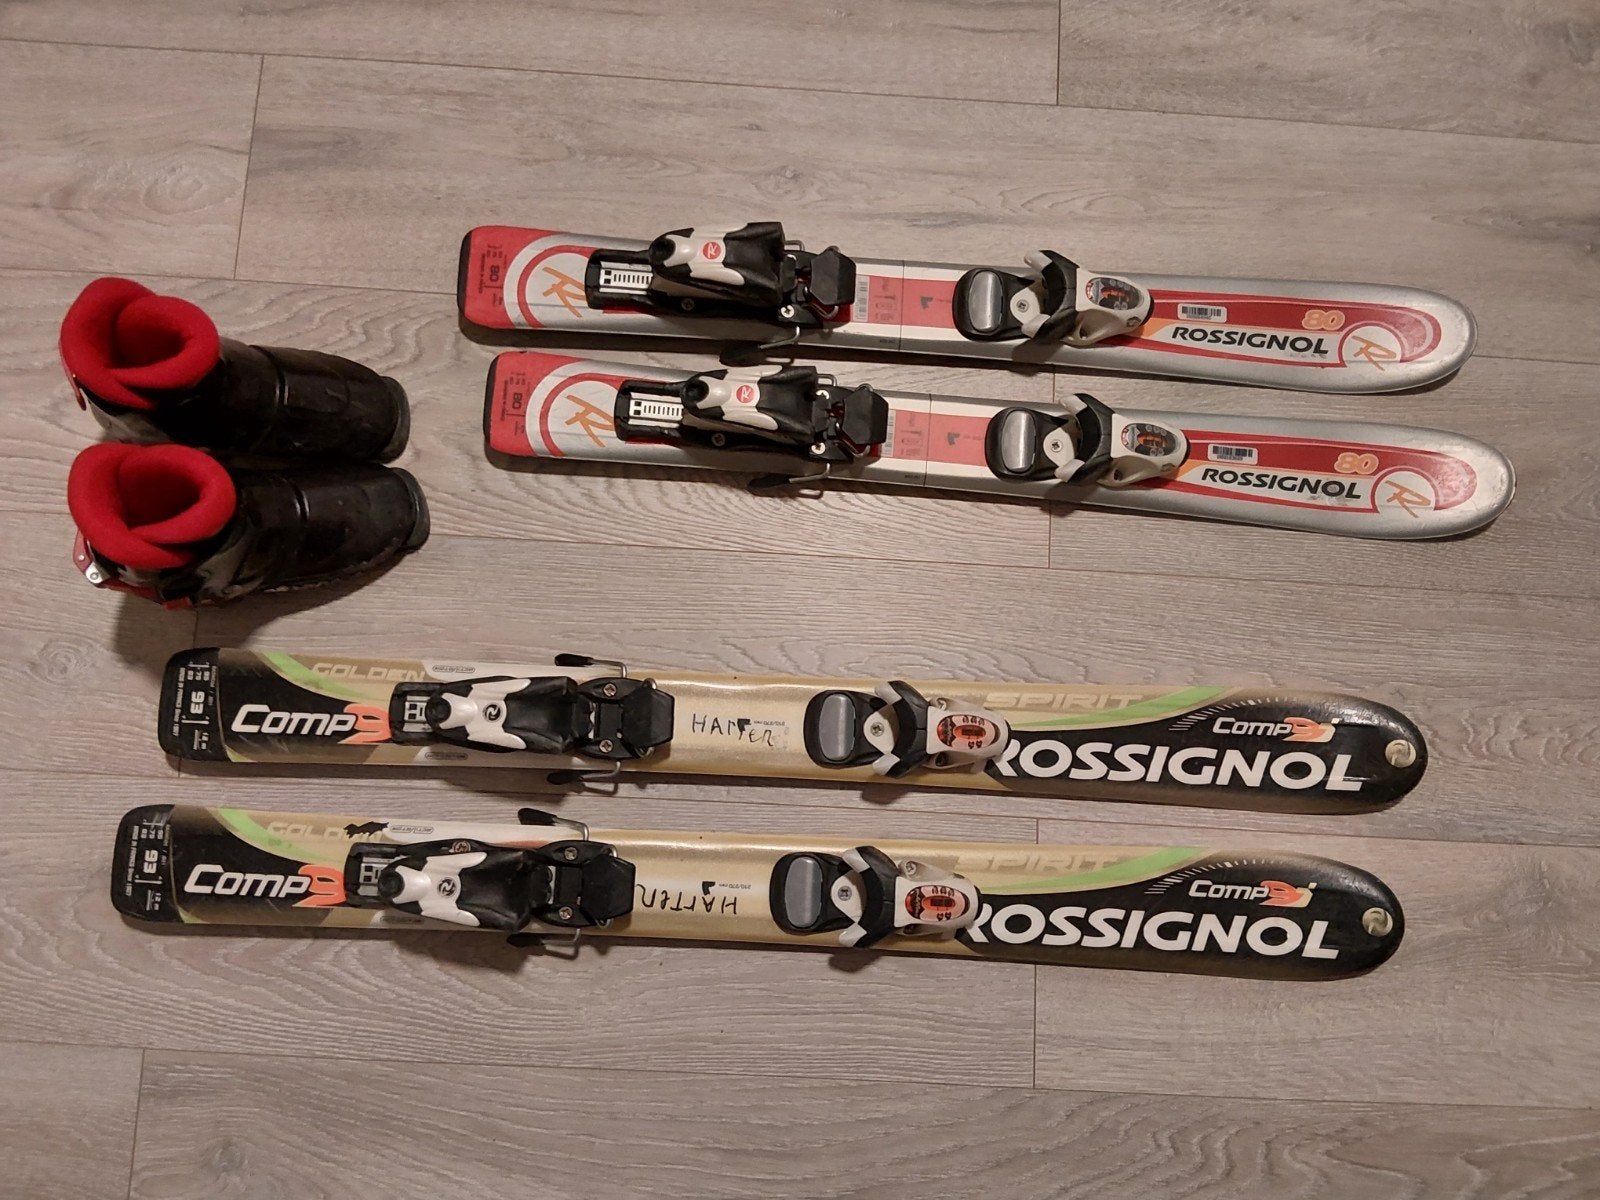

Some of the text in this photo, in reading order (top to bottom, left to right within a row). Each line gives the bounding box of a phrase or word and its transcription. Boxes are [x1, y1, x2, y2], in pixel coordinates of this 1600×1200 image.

[489, 264, 501, 283] 80
[1301, 309, 1346, 331] 80
[1171, 326, 1329, 355] ROSSIGNOL
[512, 392, 523, 410] 80
[1334, 452, 1379, 475] 80
[1201, 468, 1362, 499] ROSSIGNOL
[311, 662, 426, 682] GOLDEN
[190, 691, 205, 714] 93
[983, 692, 1143, 709] SPIRIT
[143, 849, 159, 874] 93
[954, 853, 1120, 873] SPIRIT
